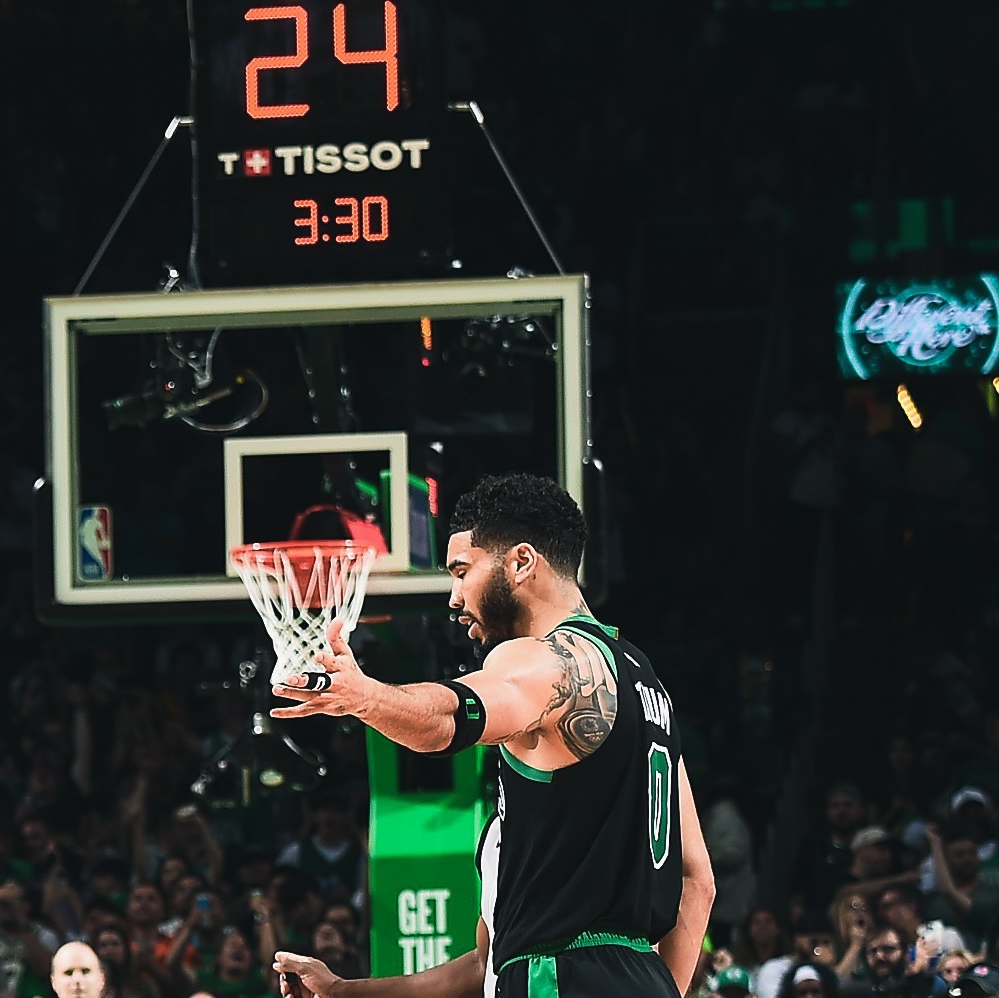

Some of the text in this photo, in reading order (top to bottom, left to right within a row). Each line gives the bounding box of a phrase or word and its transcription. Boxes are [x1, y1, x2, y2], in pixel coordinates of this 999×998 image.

[244, 0, 398, 119] 24
[275, 139, 430, 175] TISSOT
[293, 196, 389, 246] 3:30
[647, 741, 672, 870] 0
[398, 888, 451, 935] GET
[398, 937, 452, 976] THE
